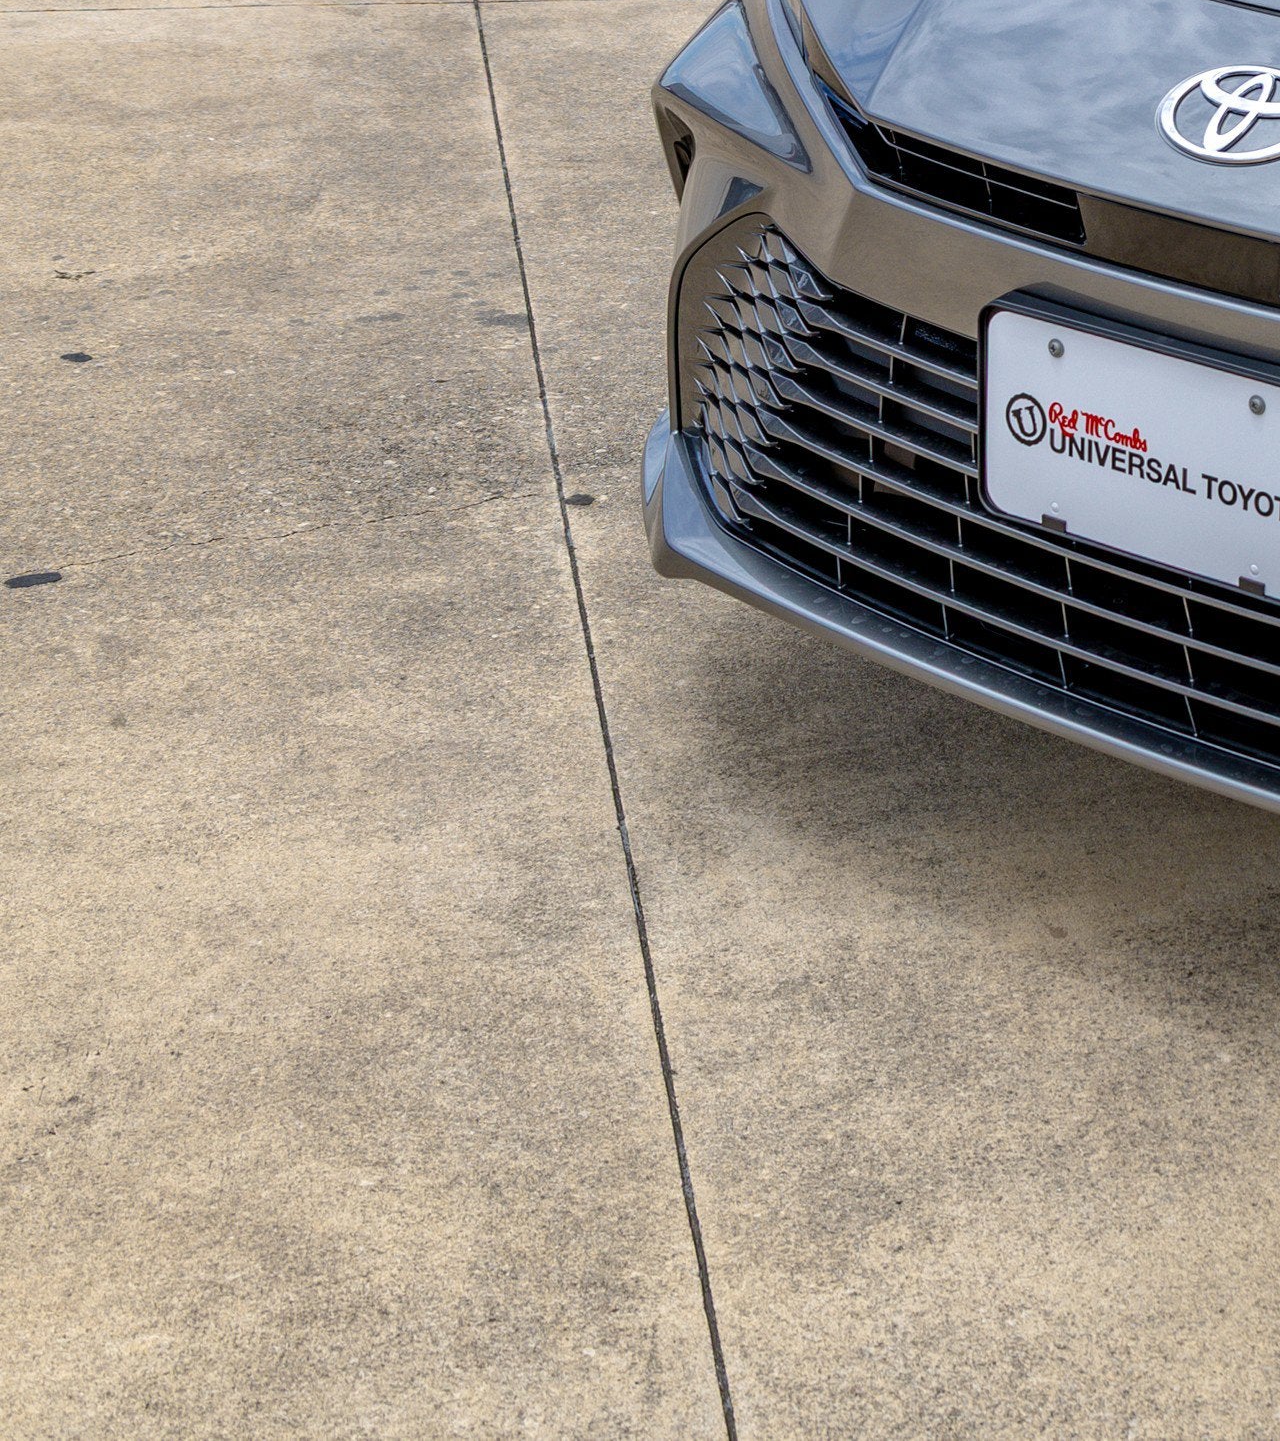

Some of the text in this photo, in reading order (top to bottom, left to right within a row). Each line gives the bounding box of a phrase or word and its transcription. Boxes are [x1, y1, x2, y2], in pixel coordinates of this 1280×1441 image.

[1049, 402, 1148, 453] Red McCombs
[1050, 427, 1197, 495] UNIVERSAL
